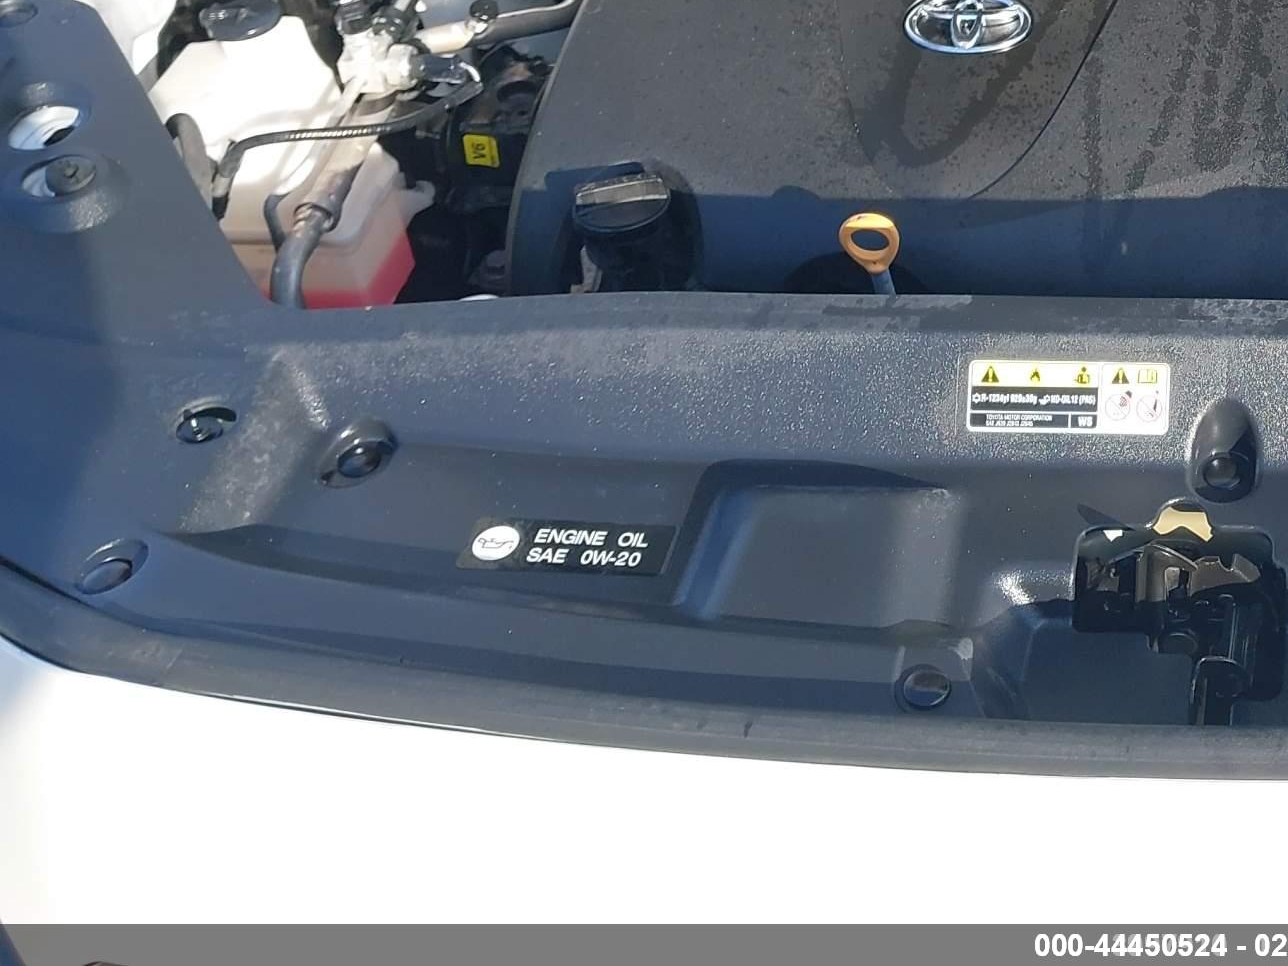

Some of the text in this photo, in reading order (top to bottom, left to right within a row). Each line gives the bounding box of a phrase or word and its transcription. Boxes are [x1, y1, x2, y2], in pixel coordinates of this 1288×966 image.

[1003, 413, 1020, 421] MOTOR
[1020, 413, 1053, 422] CORPORATION
[534, 528, 649, 548] ENGINE OIL
[526, 547, 642, 567] SAE 0W-20
